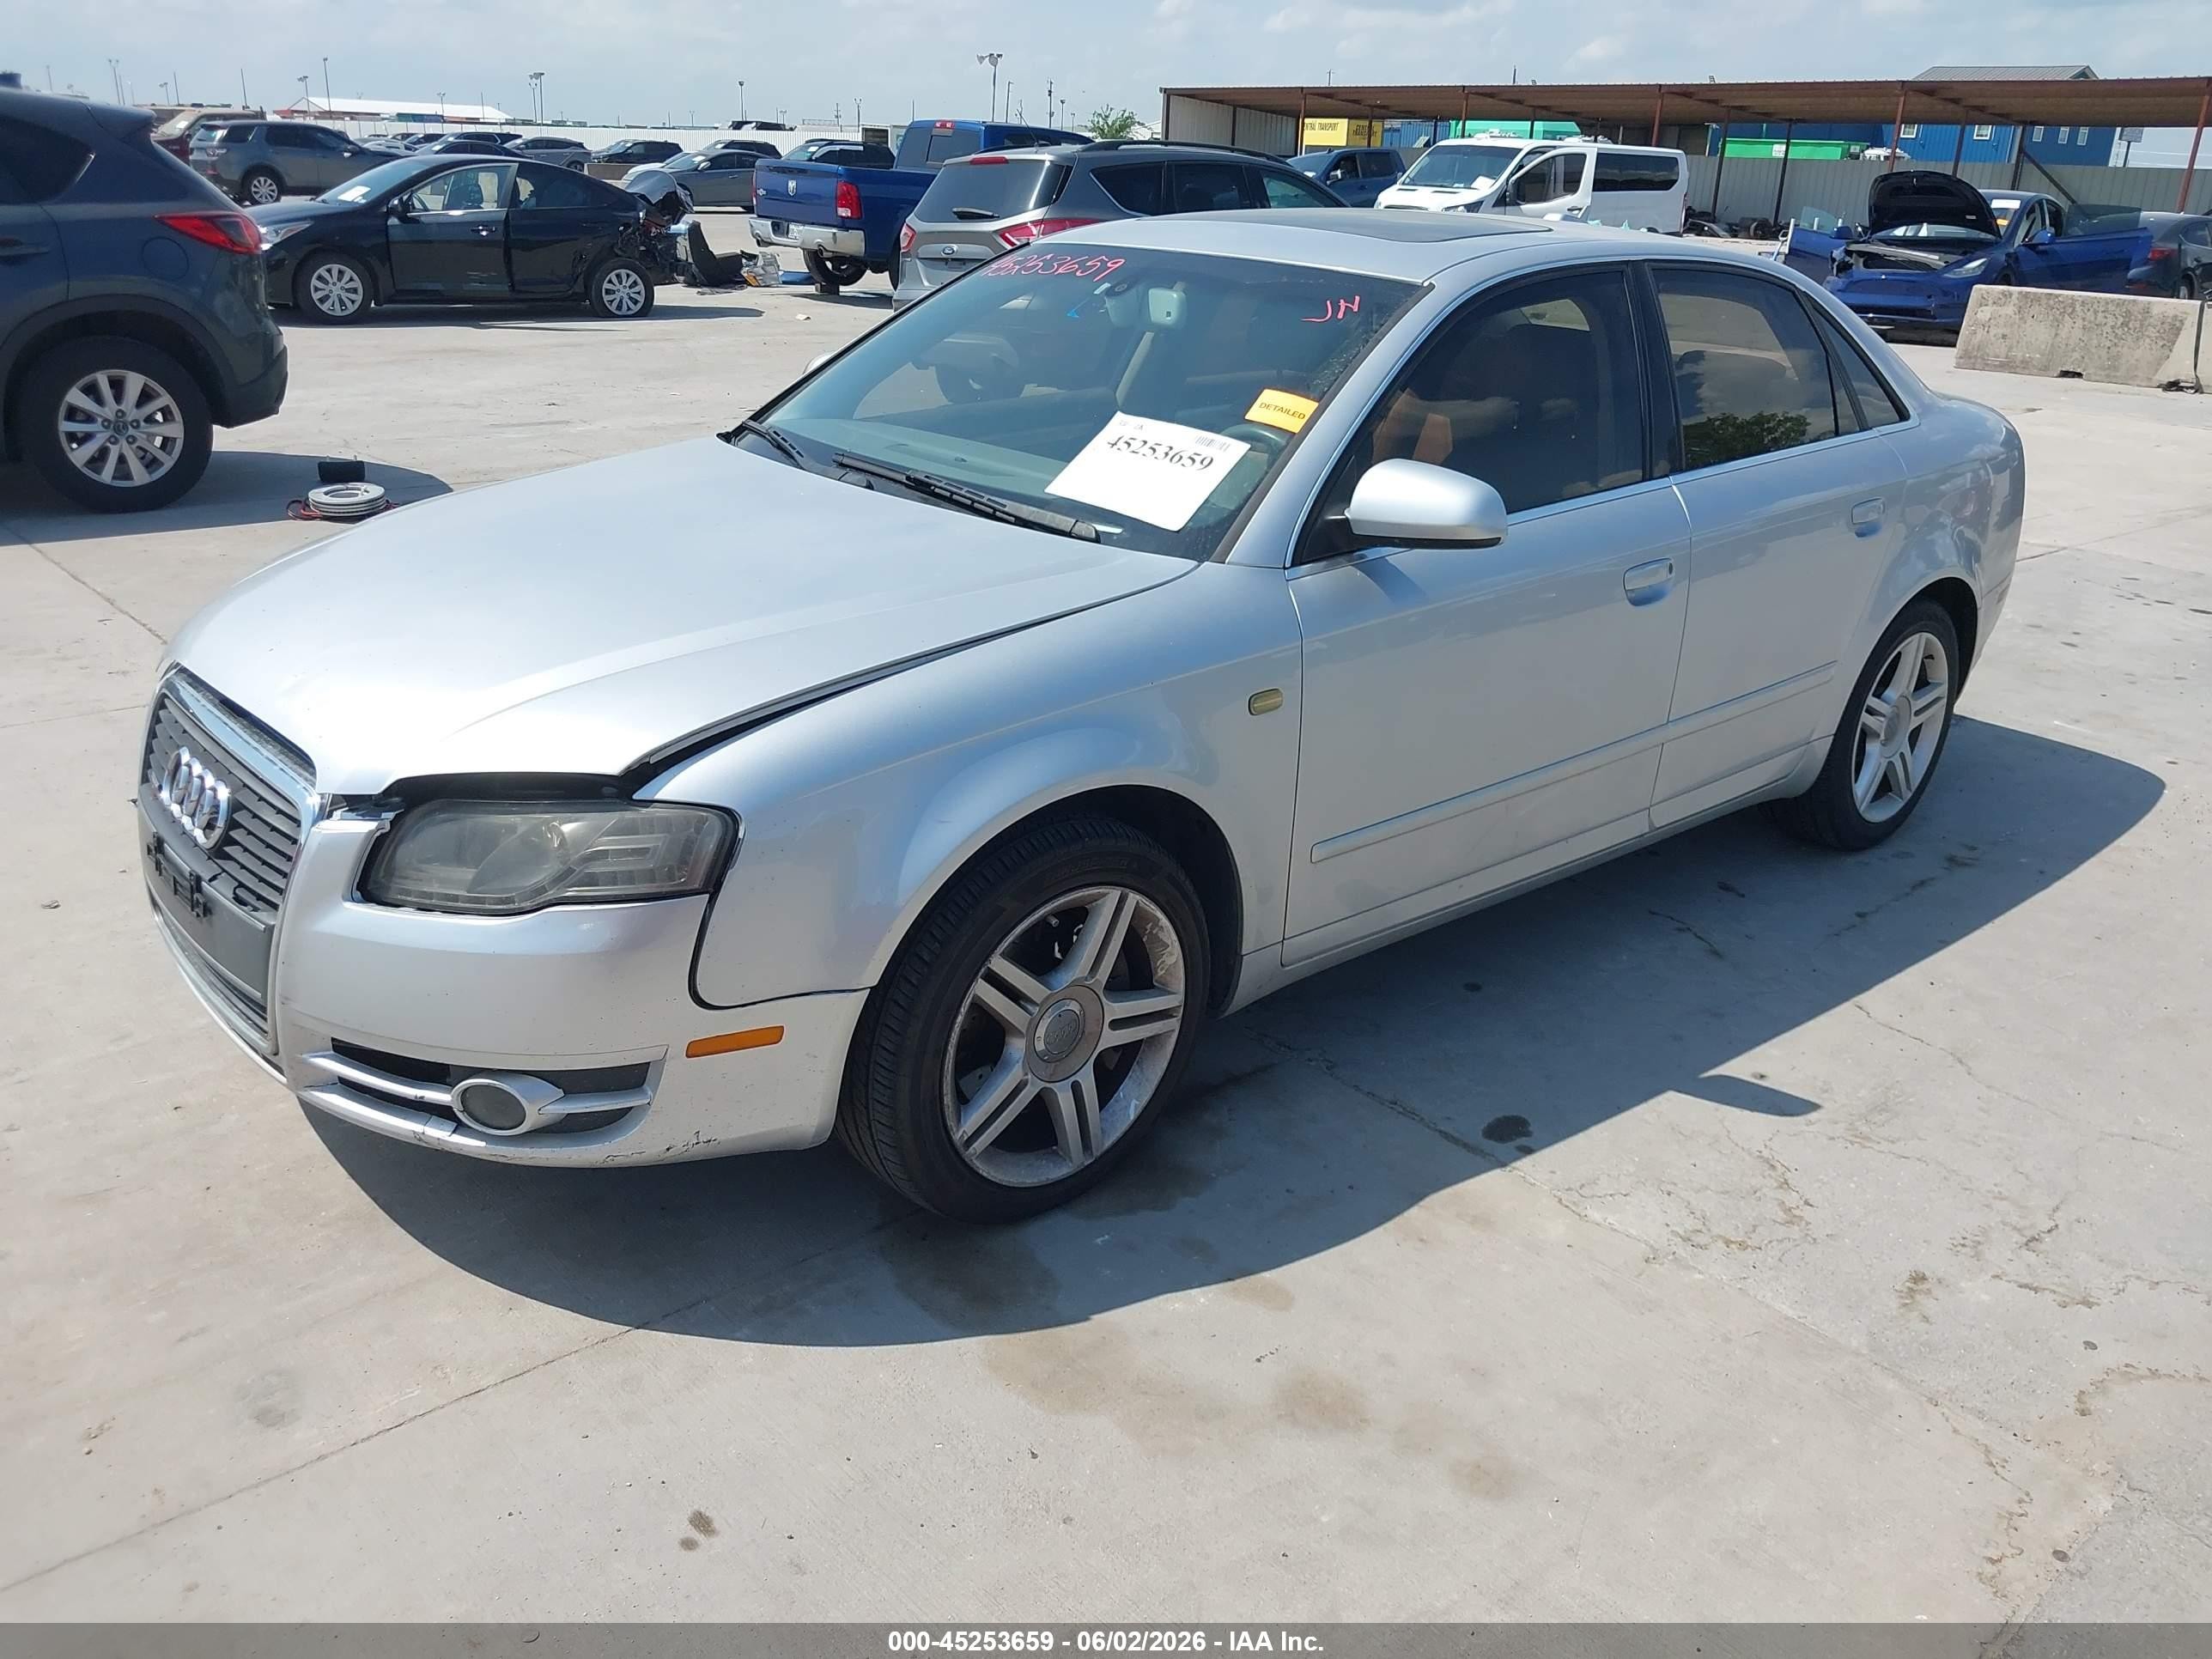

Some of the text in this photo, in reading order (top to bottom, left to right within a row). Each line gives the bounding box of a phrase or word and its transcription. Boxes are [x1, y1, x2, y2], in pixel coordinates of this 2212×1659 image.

[981, 253, 1126, 282] 45253659
[1259, 402, 1306, 420] DETAILED
[1108, 435, 1213, 471] 45253659
